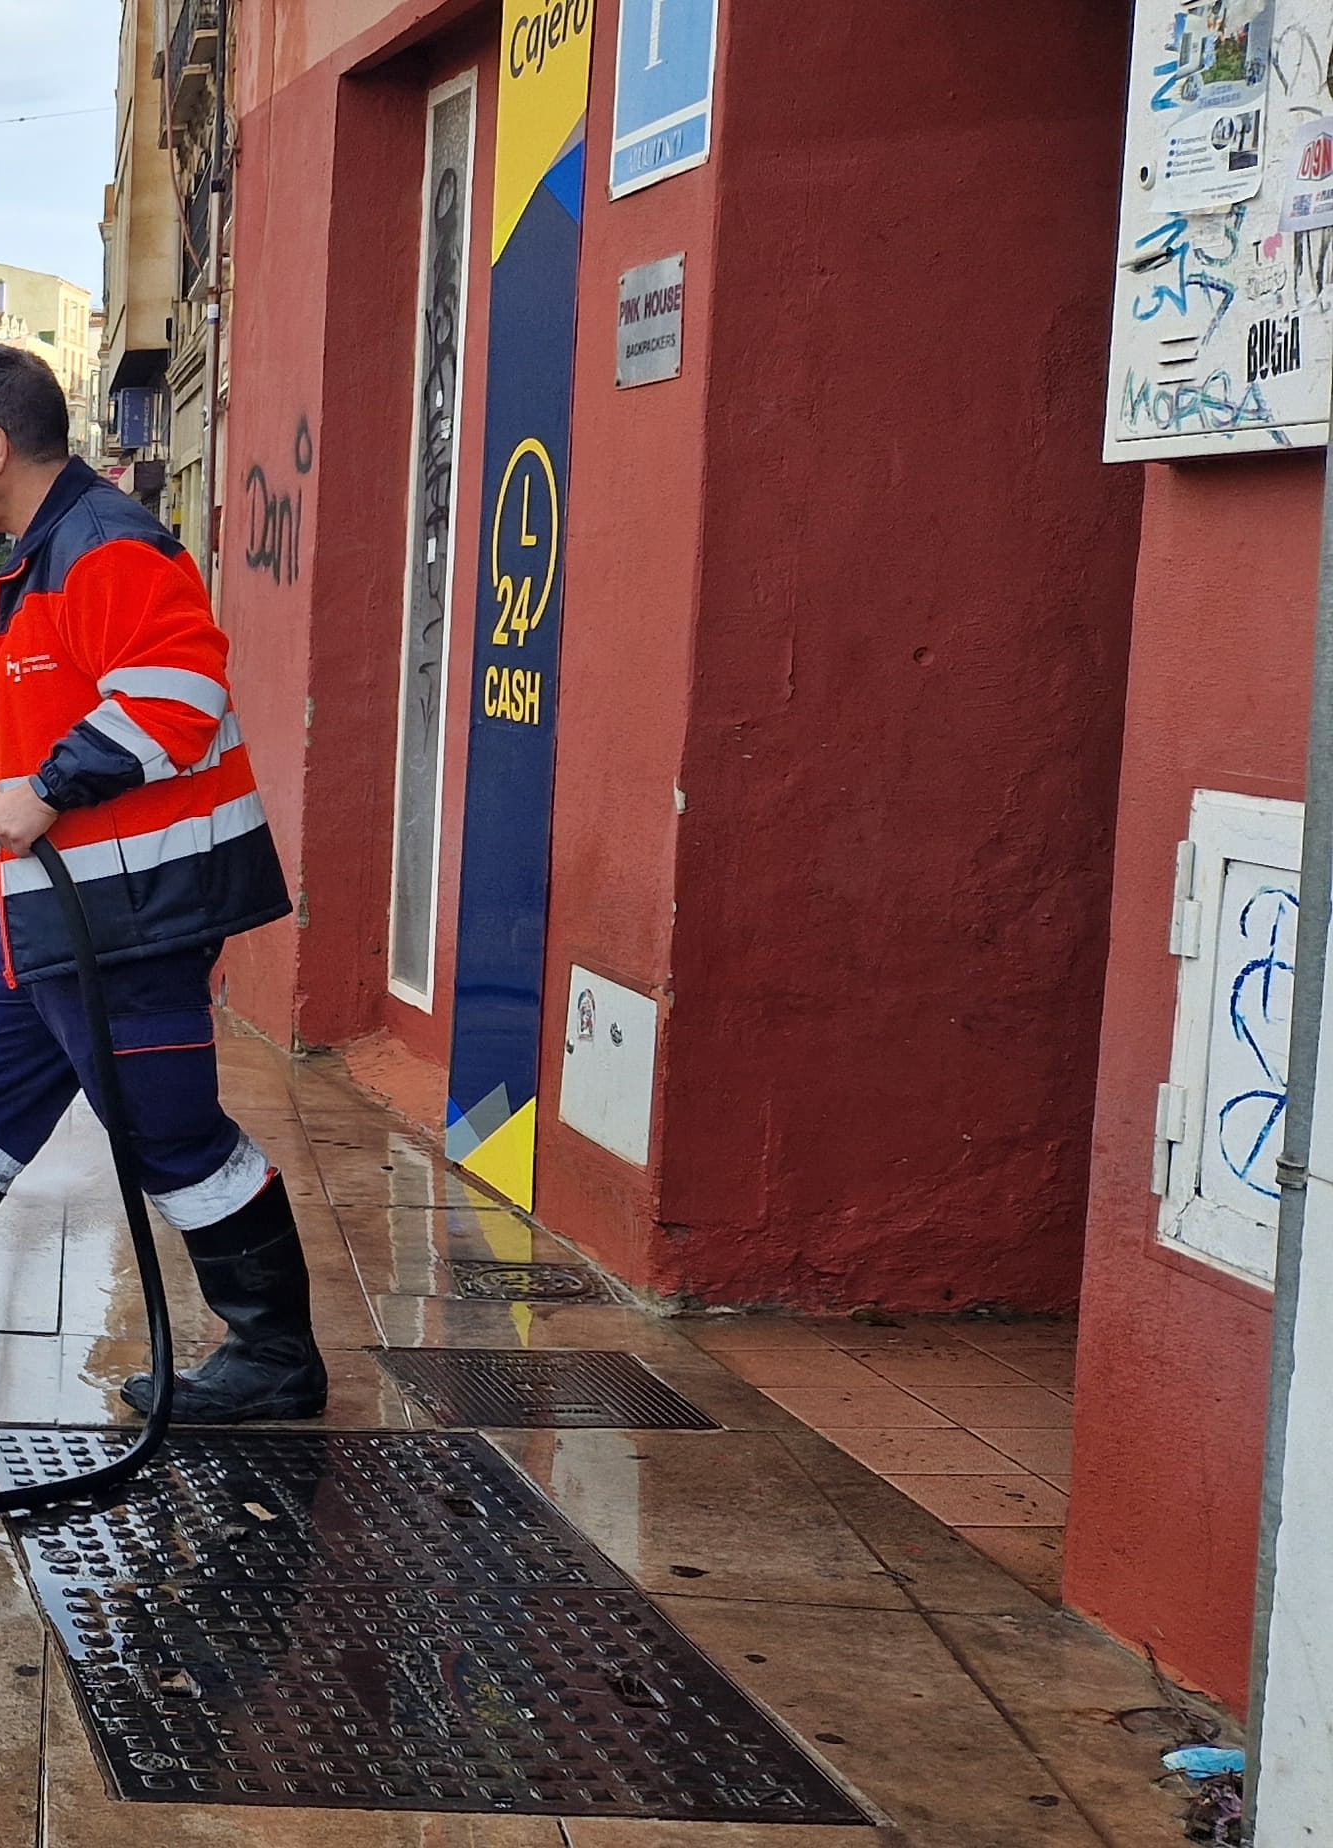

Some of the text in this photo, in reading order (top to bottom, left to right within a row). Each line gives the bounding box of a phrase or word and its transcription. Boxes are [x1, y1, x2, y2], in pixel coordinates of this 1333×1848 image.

[510, 0, 589, 79] Cajero
[619, 284, 681, 327] PINK HOUSE
[626, 333, 676, 359] BACKPACKERS
[492, 575, 532, 647] 24
[484, 665, 541, 726] CASH
